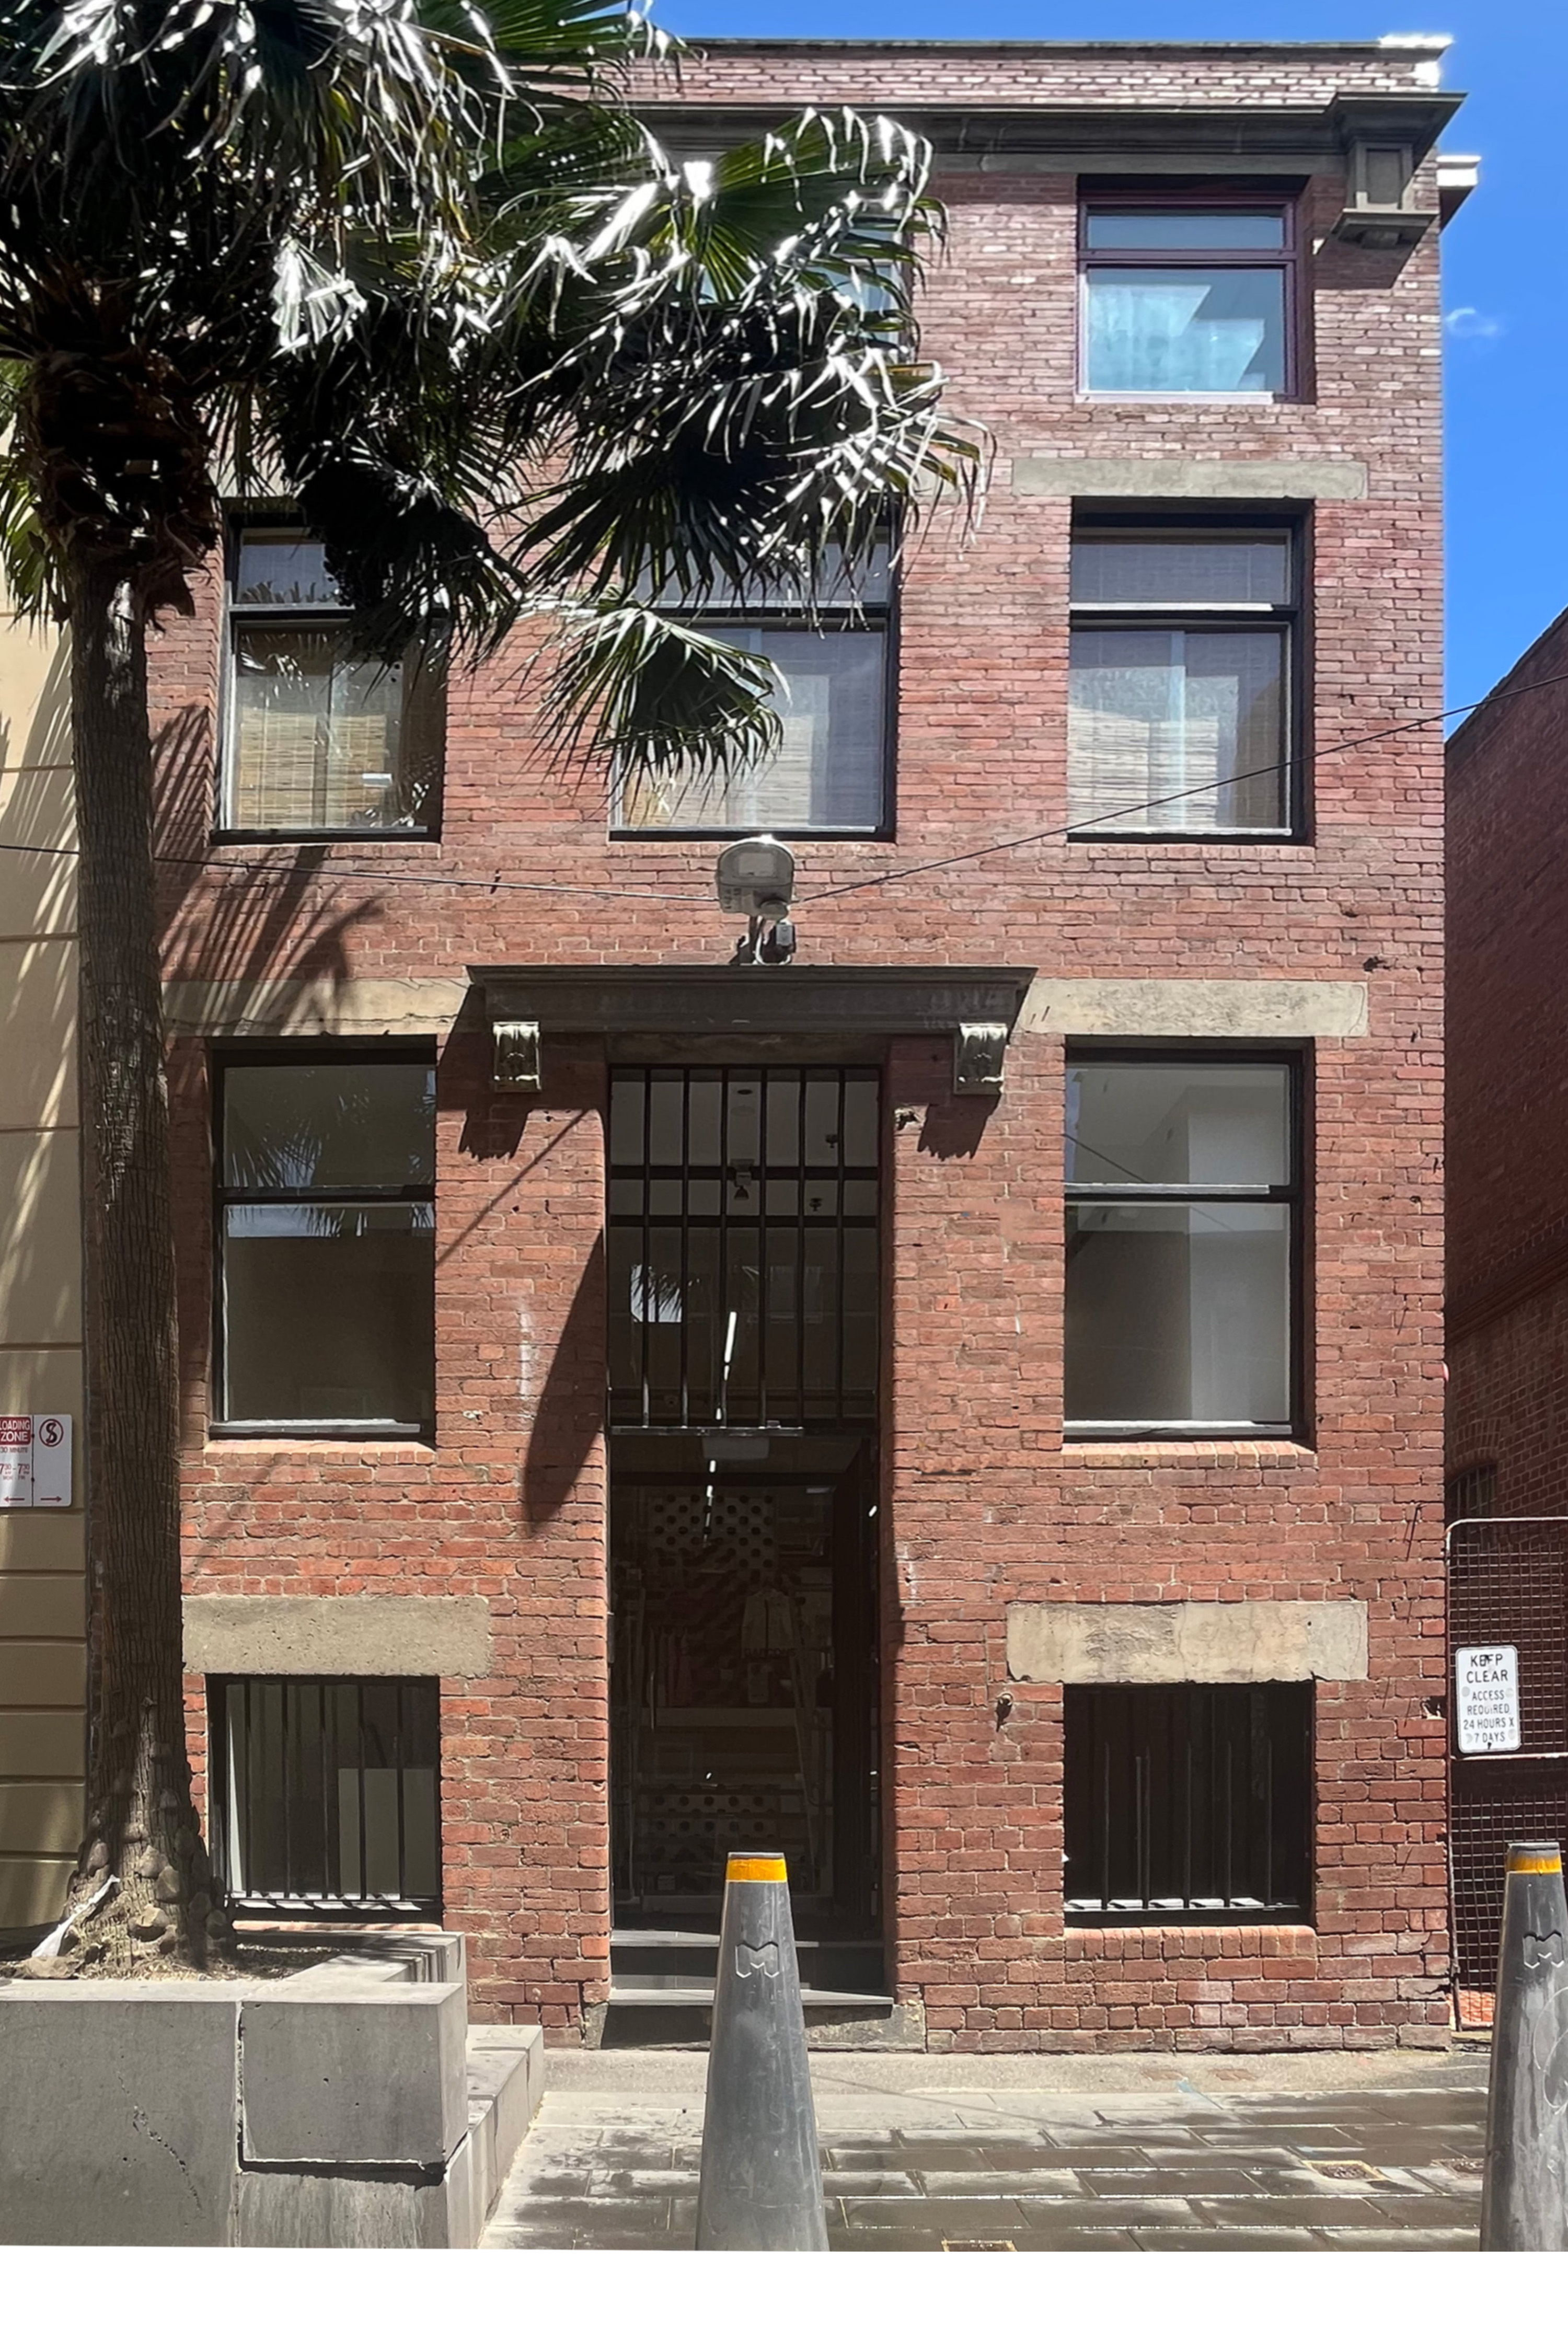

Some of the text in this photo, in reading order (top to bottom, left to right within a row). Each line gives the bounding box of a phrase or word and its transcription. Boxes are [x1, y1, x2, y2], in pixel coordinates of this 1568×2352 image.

[1, 1431, 28, 1442] ZONE
[1466, 1669, 1508, 1684] CLEAR
[1472, 1689, 1504, 1701] ACCESS
[1463, 1716, 1515, 1730] 24 HOURS X
[1474, 1731, 1505, 1743] 7 DAYS
